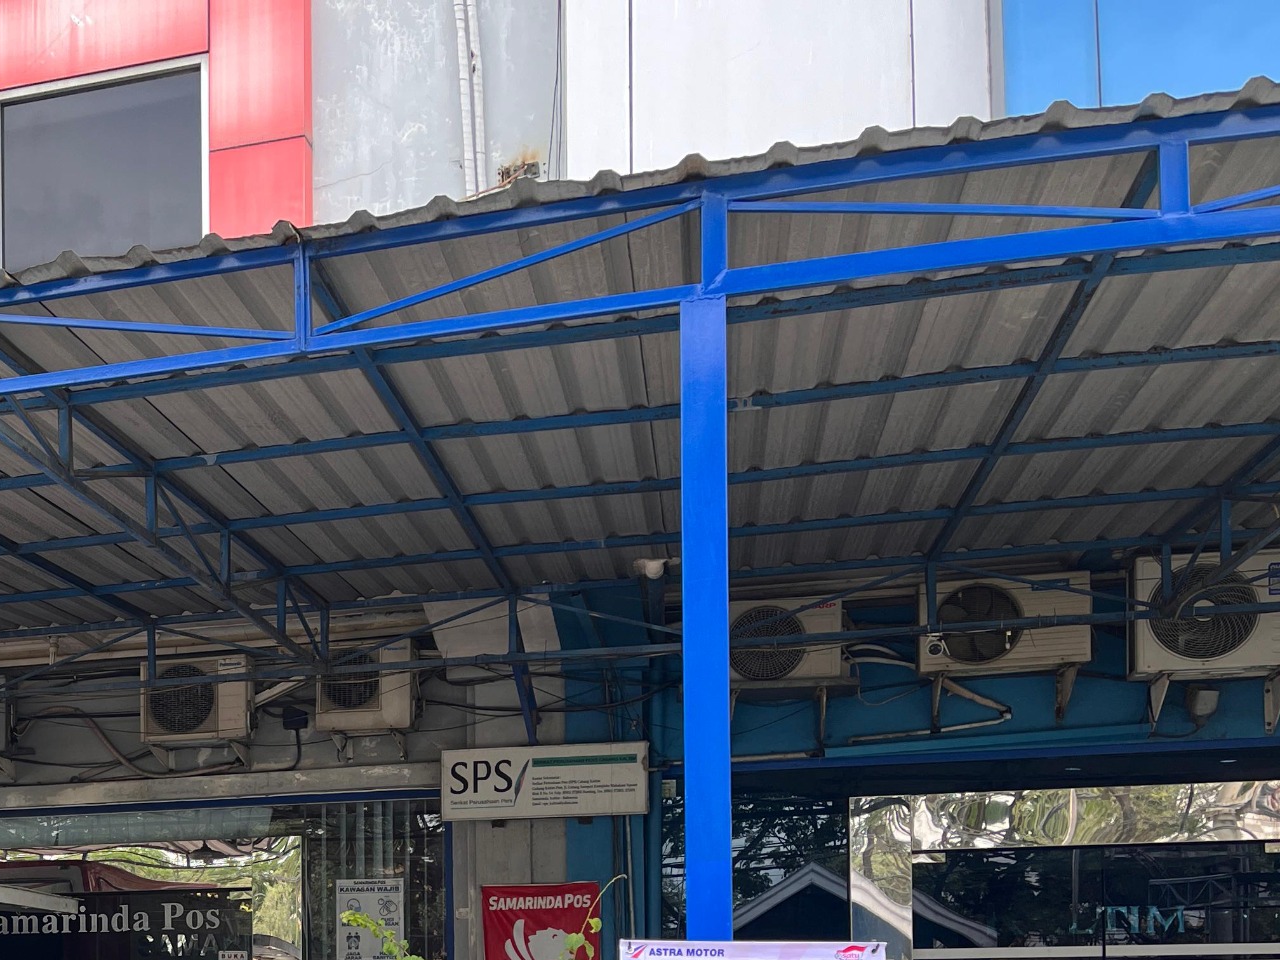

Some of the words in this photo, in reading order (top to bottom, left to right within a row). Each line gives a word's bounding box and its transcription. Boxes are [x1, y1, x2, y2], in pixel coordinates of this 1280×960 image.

[450, 759, 513, 795] SPS
[488, 895, 562, 911] SAMARINDA
[564, 893, 592, 909] POS
[161, 902, 220, 931] Pos
[648, 948, 684, 956] ASTRA
[686, 948, 725, 957] MOTOR
